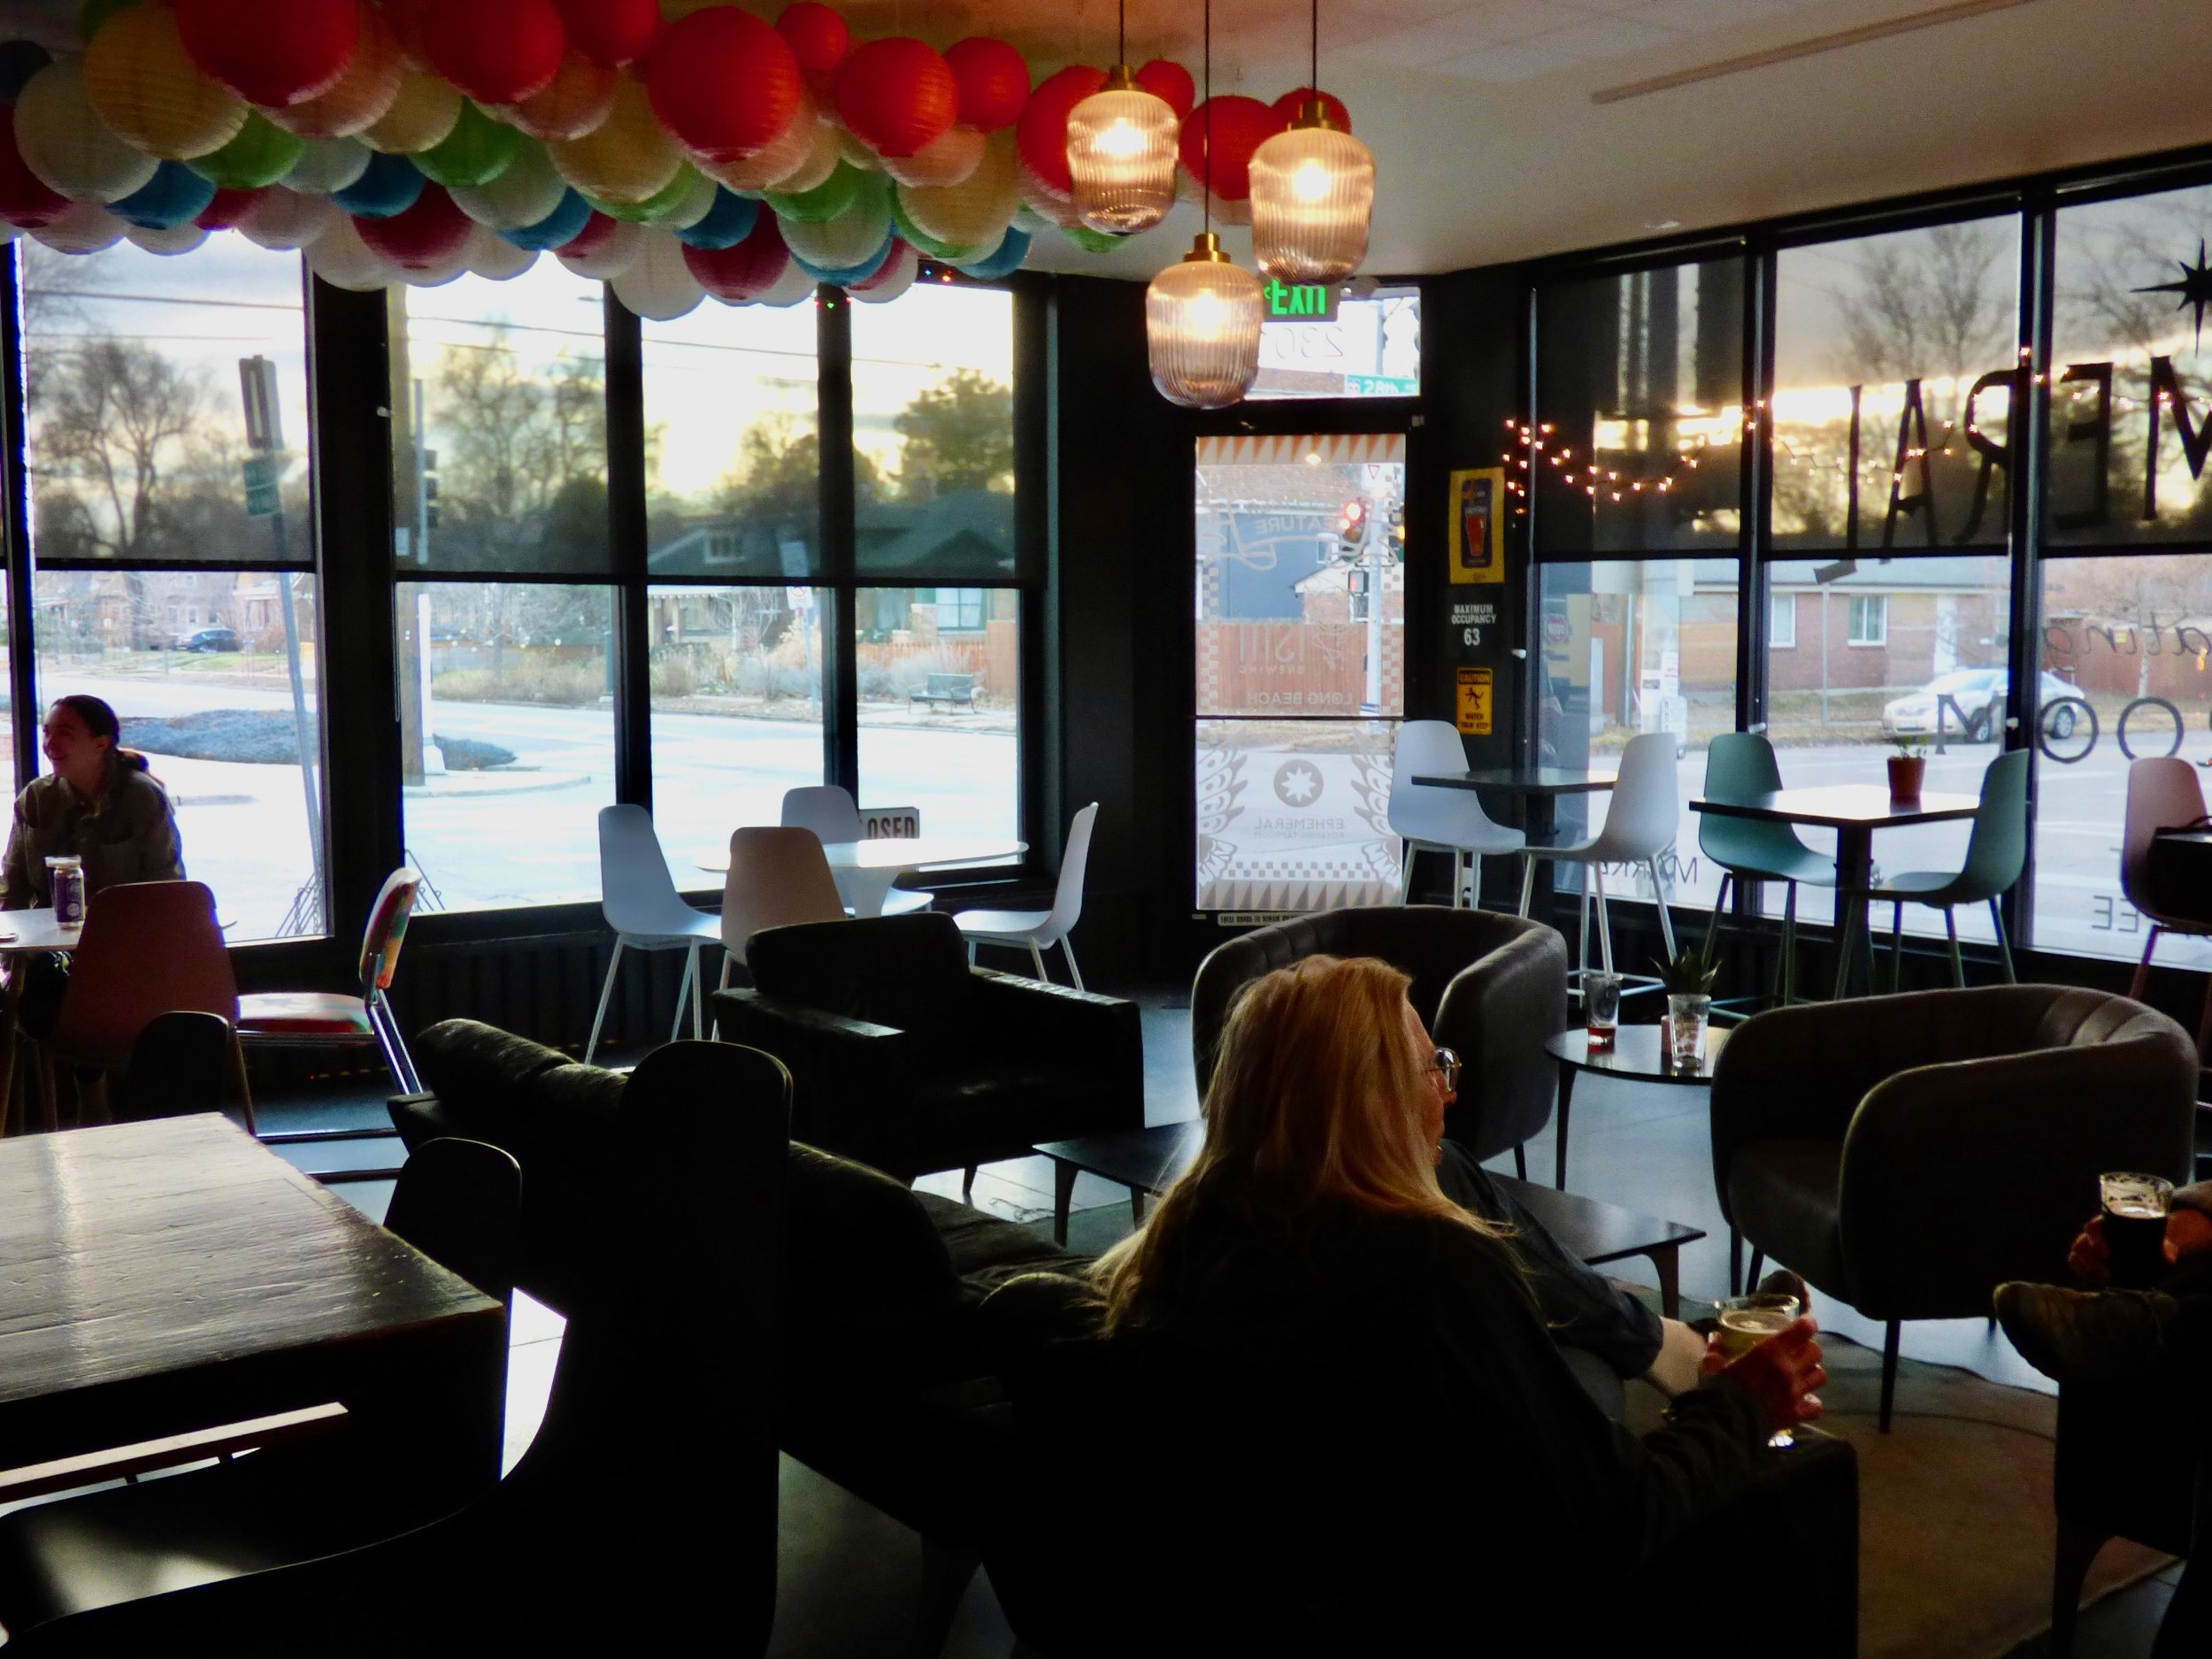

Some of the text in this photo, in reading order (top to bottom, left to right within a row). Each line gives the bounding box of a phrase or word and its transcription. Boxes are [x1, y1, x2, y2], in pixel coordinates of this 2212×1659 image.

[1454, 603, 1494, 614] MAXIMUM
[1451, 614, 1496, 625] OCCUPANCY
[1463, 627, 1480, 646] 63
[1459, 672, 1491, 683] CAUTION
